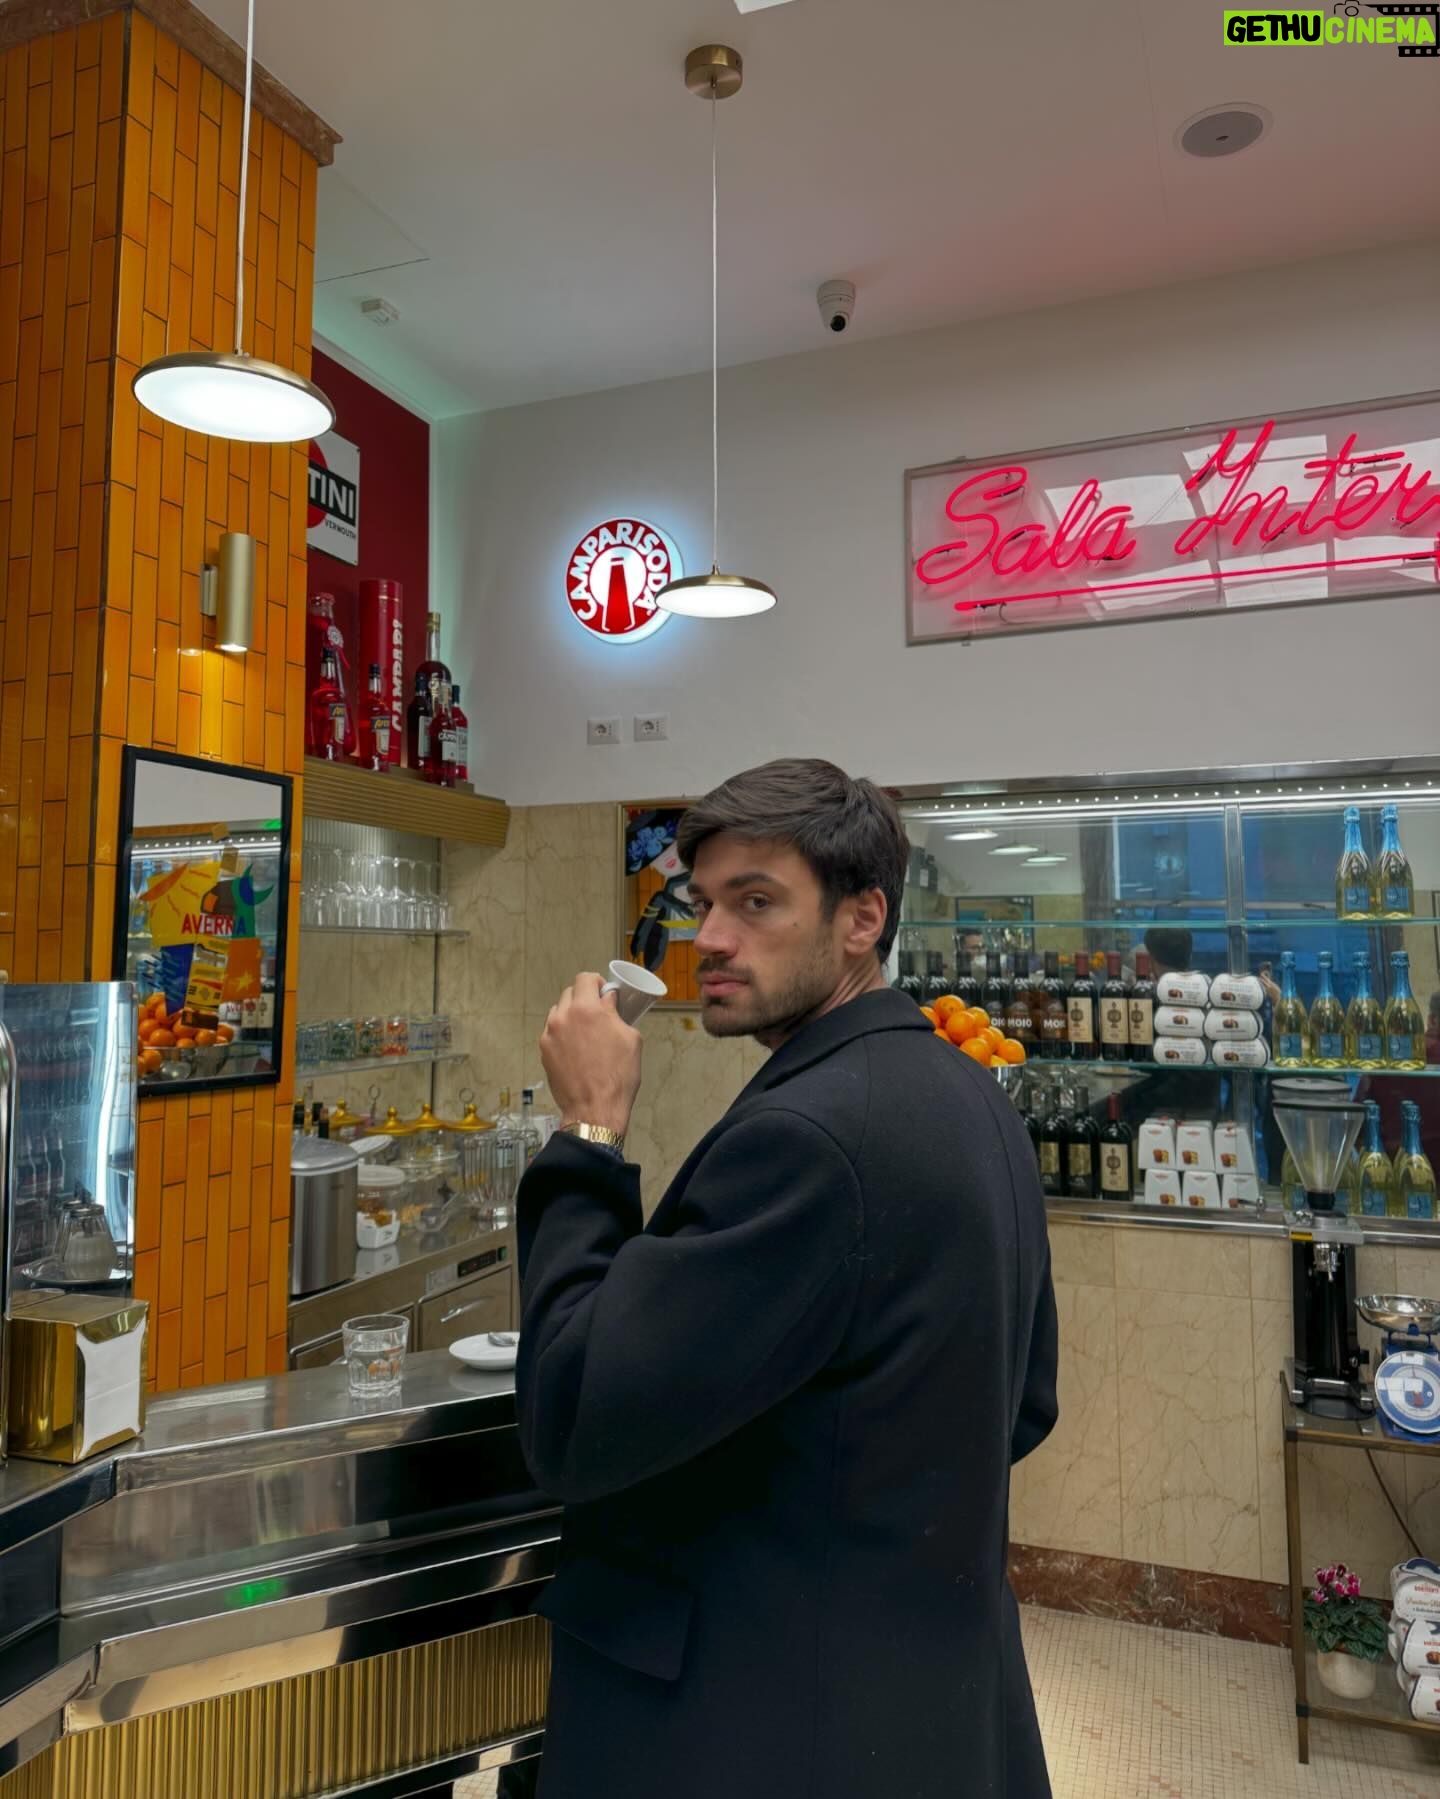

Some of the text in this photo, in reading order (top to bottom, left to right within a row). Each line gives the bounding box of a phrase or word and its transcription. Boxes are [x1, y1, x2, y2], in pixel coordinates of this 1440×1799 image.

[325, 517, 356, 539] VERMOUTH
[917, 420, 1440, 585] Sala Inter
[391, 618, 403, 732] CAMPARI
[181, 912, 247, 935] AVERNA
